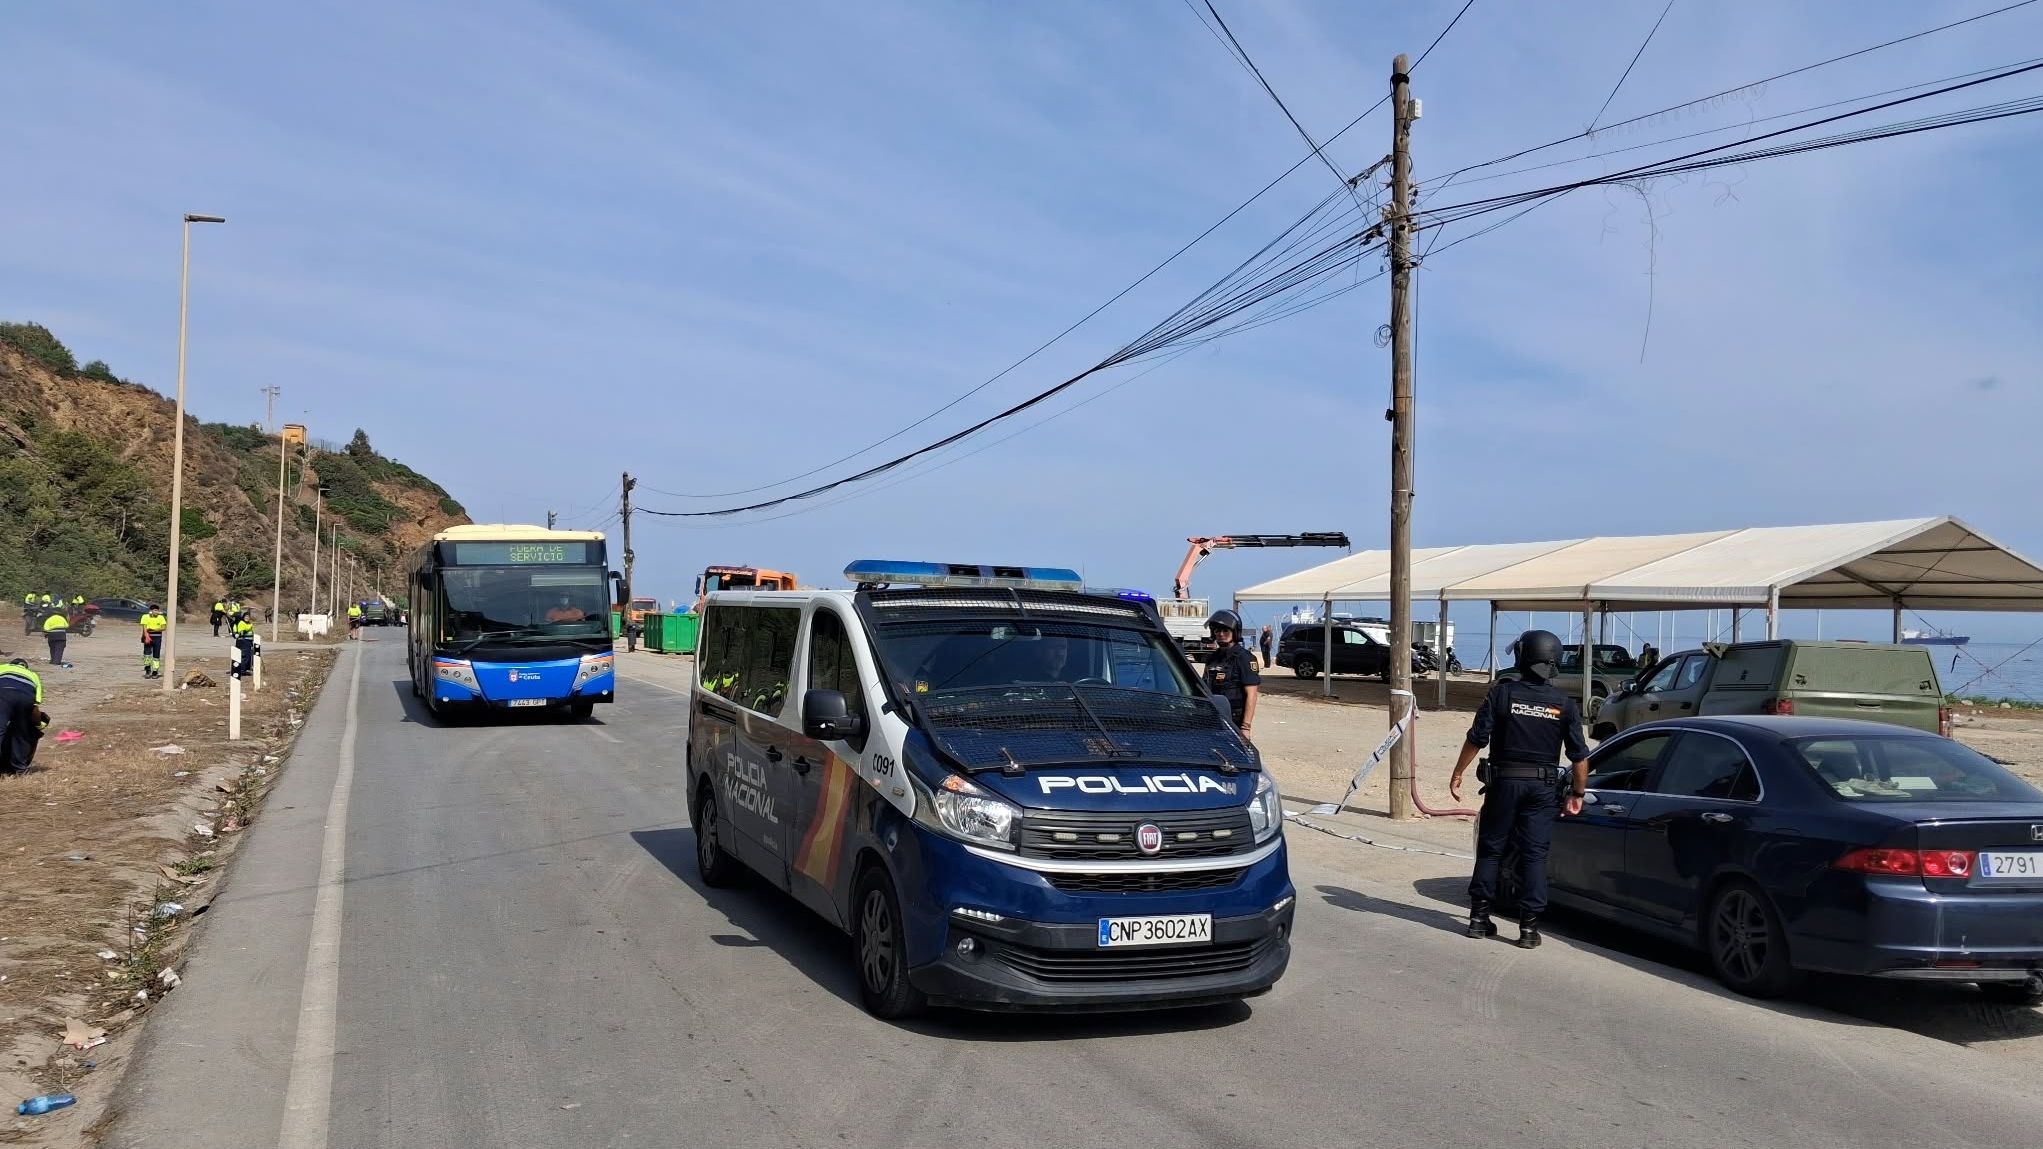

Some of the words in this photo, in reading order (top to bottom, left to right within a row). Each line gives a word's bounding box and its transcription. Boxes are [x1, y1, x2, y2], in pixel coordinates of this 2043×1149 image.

[510, 552, 563, 562] SERVICIO
[1511, 709, 1560, 721] NACIONAL
[1037, 772, 1227, 795] POLICÍA
[724, 776, 779, 824] NACIONAL
[1142, 832, 1158, 846] FIAT
[1994, 856, 2036, 874] 2791
